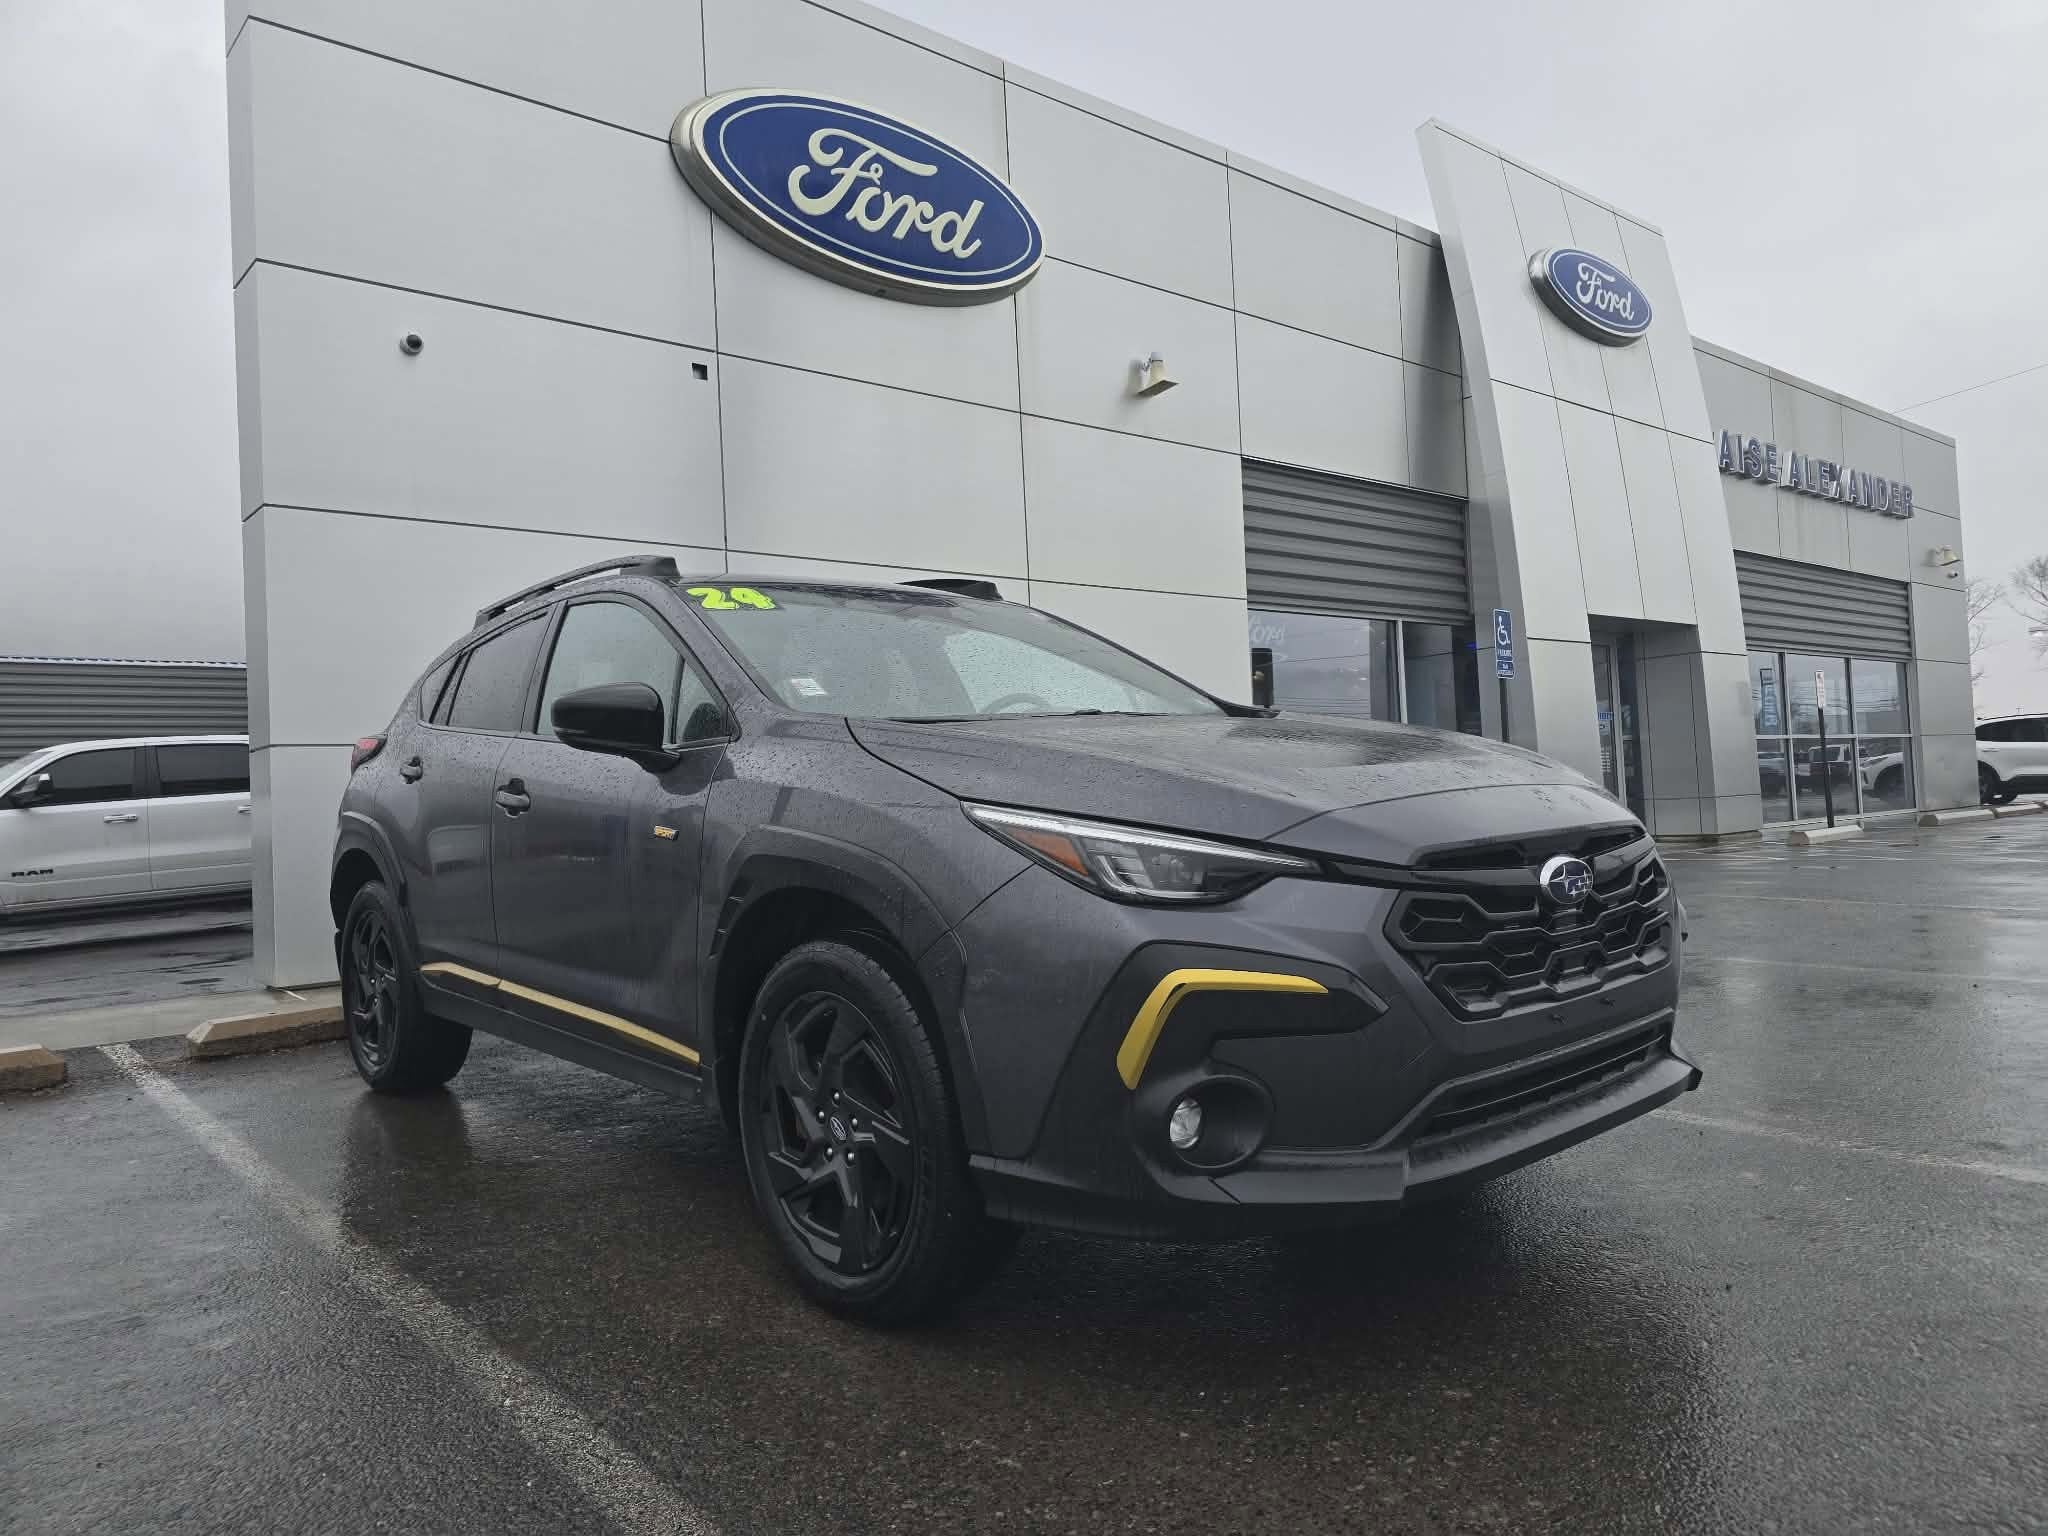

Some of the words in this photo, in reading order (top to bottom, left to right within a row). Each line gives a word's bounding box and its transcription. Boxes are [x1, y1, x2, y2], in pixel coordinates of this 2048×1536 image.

[788, 128, 984, 259] Ford
[1576, 262, 1635, 320] Ford
[1782, 450, 1914, 519] ALEXANDER
[11, 868, 54, 878] RAM
